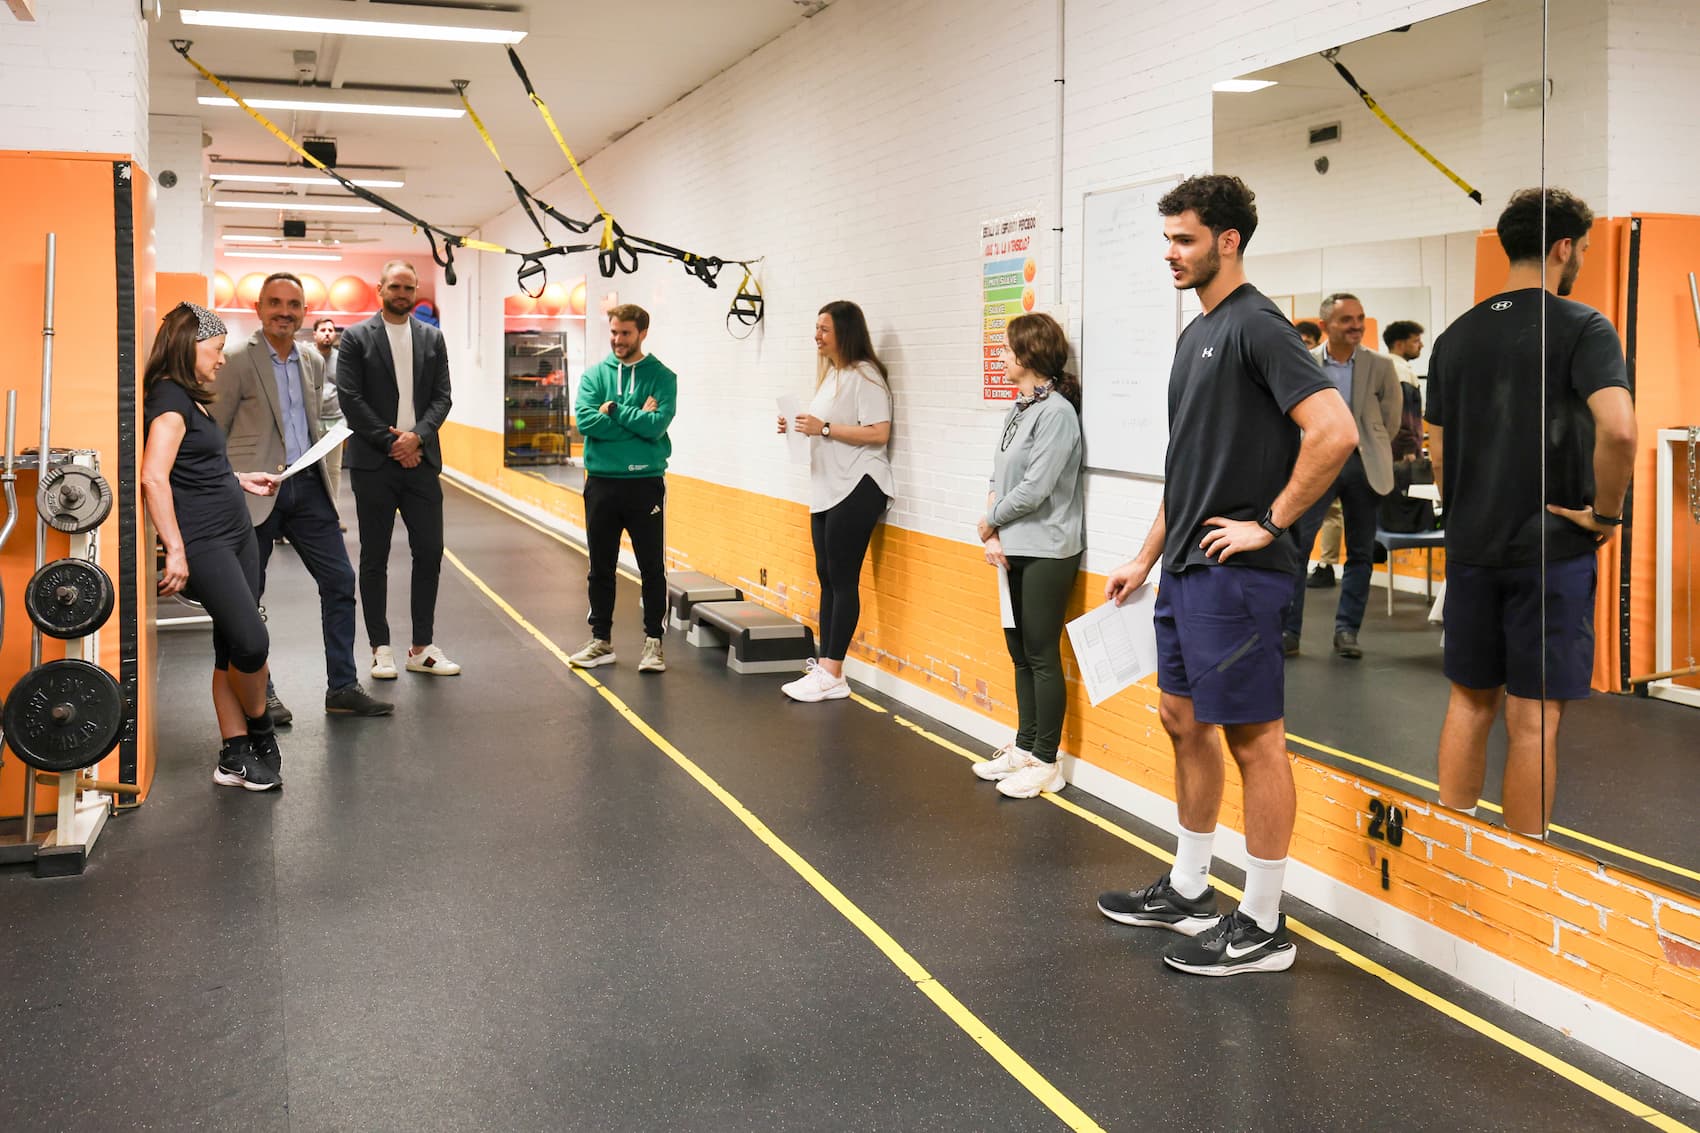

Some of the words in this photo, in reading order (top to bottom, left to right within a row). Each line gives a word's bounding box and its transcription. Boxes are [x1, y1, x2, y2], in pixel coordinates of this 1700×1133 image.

[1000, 273, 1017, 286] SUAVE
[988, 304, 1005, 315] SUAVE
[990, 375, 1001, 384] MUY
[984, 388, 992, 398] 10
[992, 389, 1013, 398] EXTREMO
